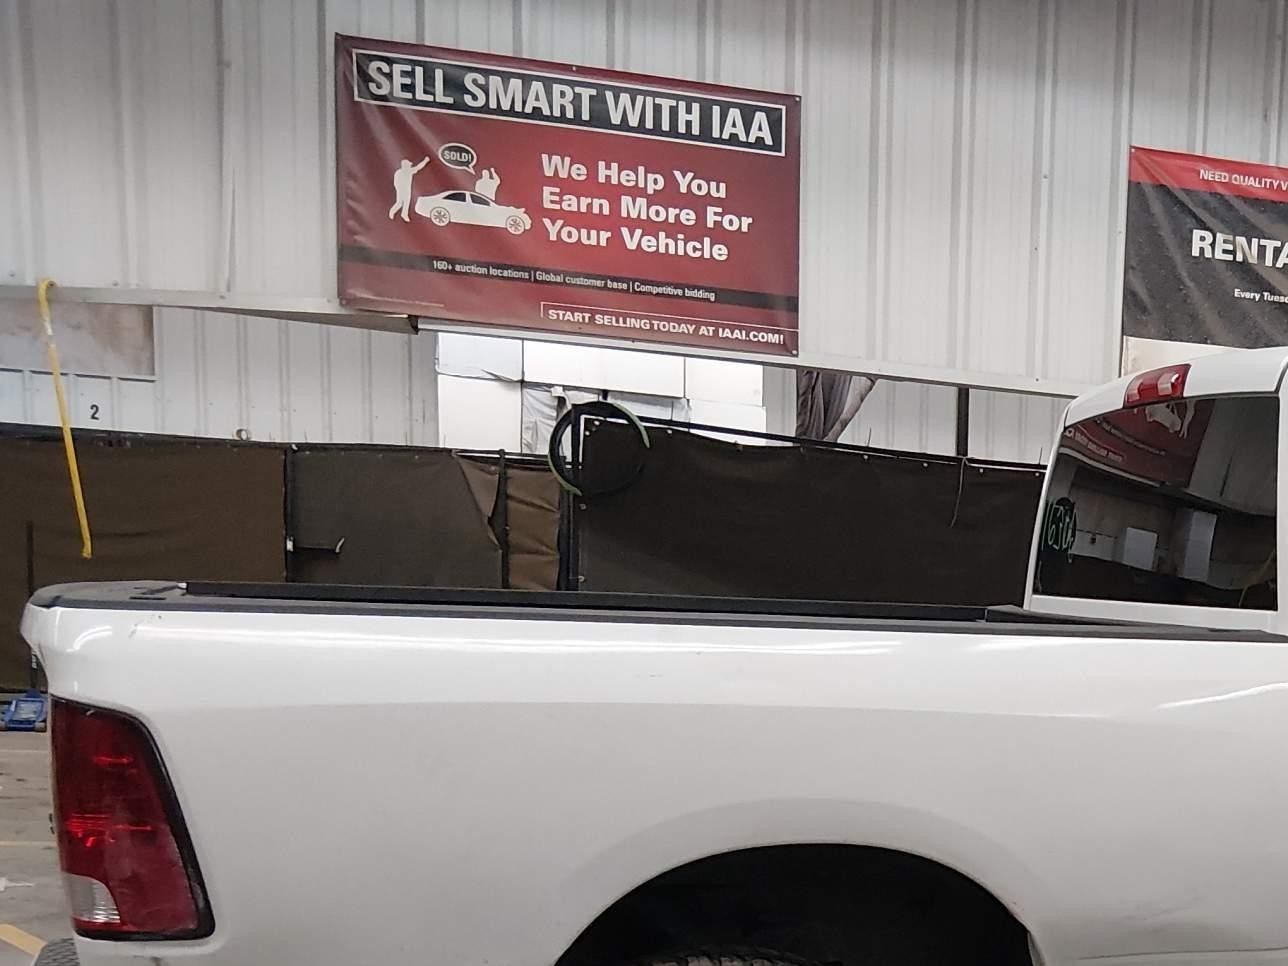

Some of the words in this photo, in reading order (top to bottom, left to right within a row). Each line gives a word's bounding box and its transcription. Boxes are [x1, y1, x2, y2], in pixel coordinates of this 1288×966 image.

[367, 61, 454, 104] SELL
[463, 73, 597, 121] SMART
[605, 90, 700, 136] WITH
[712, 105, 774, 146] IAA
[443, 150, 472, 162] SOLD!
[541, 153, 588, 181] We
[598, 160, 665, 195] Help
[673, 170, 727, 198] You
[1199, 169, 1230, 183] NEED
[1231, 174, 1280, 191] QUALITY
[542, 186, 610, 215] Earn
[620, 195, 697, 226] More
[706, 206, 753, 233] For
[542, 218, 612, 247] Your
[620, 227, 729, 261] Vehicle
[433, 260, 452, 270] 160+
[455, 264, 488, 275] auction
[489, 266, 529, 279] locations
[535, 271, 564, 283] Global
[565, 276, 605, 288] customer
[607, 279, 628, 290] base
[634, 281, 684, 296] Competitive
[685, 287, 716, 302] bidding
[1234, 288, 1261, 302] Every
[549, 309, 592, 323] START
[594, 314, 650, 330] SELLING
[652, 320, 696, 335] TODAY
[699, 325, 716, 337] AT
[718, 328, 785, 345] IAAI.COM!
[90, 404, 100, 420] 2
